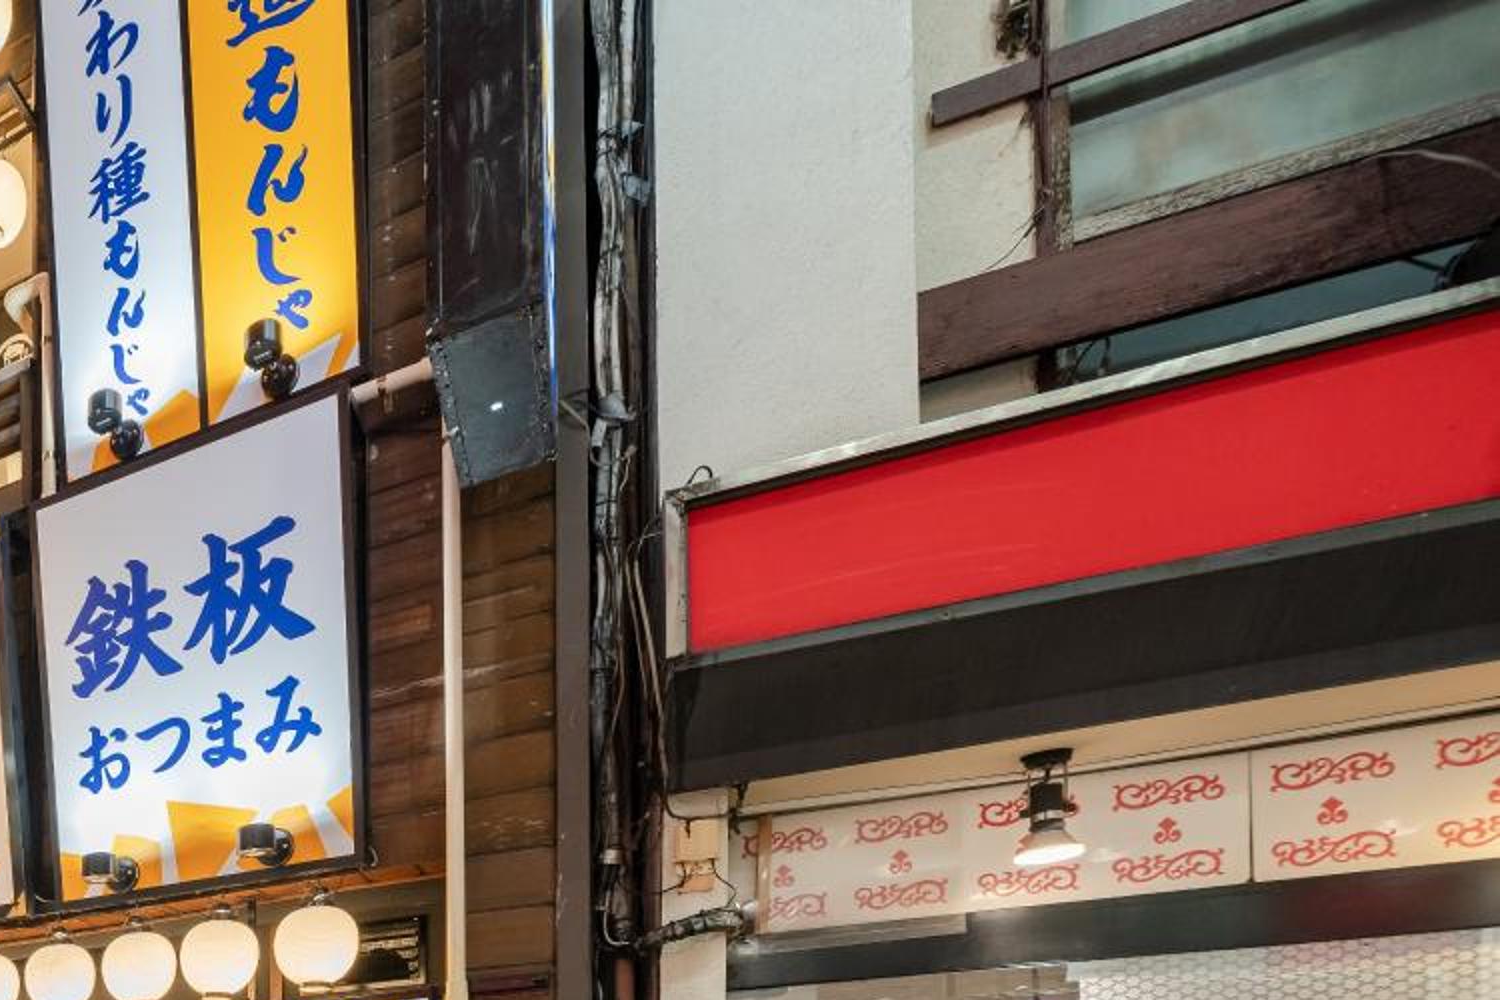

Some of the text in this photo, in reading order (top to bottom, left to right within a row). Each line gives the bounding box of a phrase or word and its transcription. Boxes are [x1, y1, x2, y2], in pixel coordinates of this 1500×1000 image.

[78, 0, 150, 416] わり種もんじゃ
[64, 515, 316, 699] 鉄板
[79, 675, 323, 795] おつまみ
